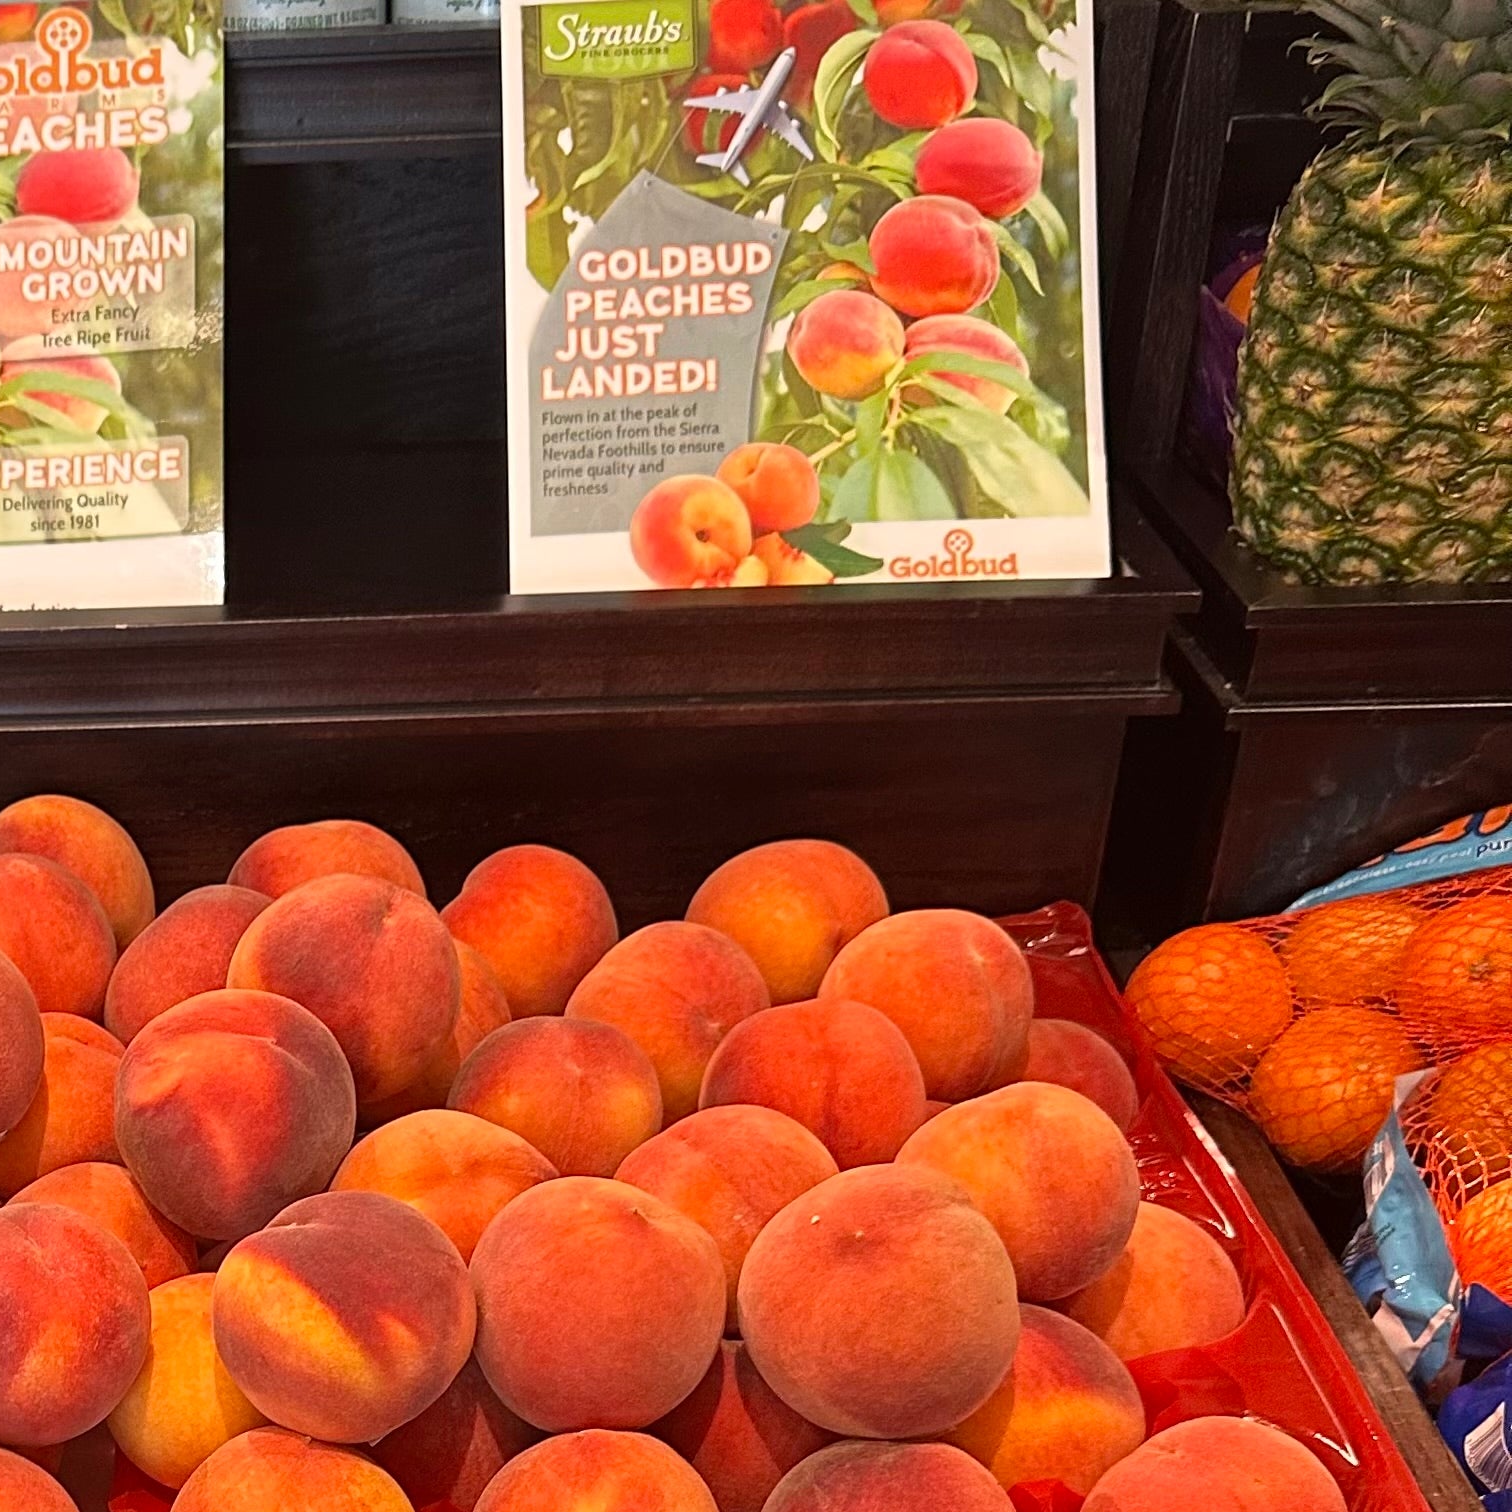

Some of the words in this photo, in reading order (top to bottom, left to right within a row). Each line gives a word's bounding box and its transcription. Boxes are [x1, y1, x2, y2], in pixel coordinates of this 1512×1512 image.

[544, 10, 682, 61] Straub's
[578, 242, 772, 282] GOLDBUD
[22, 262, 164, 302] GROWN
[565, 281, 753, 322] PEACHES
[51, 308, 90, 324] Extra
[95, 305, 140, 326] Fancy
[41, 332, 72, 348] Tree
[77, 330, 111, 350] Ripe
[116, 326, 150, 343] Fruit
[555, 323, 664, 362] JUST
[542, 358, 717, 401] LANDED!
[542, 411, 583, 425] Flown
[587, 410, 600, 423] in
[603, 410, 616, 422] at
[621, 407, 643, 421] the
[646, 405, 679, 422] peak
[683, 402, 698, 417] of
[542, 426, 612, 446] perfection
[616, 425, 650, 440] from
[654, 423, 676, 437] the
[679, 422, 720, 436] Sierra
[543, 446, 594, 461] Nevada
[598, 442, 657, 458] Foothills
[661, 442, 675, 455] to
[678, 441, 725, 454] ensure
[543, 465, 583, 482] prime
[587, 461, 635, 479] quality
[638, 459, 665, 473] and
[543, 482, 609, 497] freshness
[2, 496, 73, 513] Delivering
[77, 492, 129, 509] Quality
[31, 517, 66, 532] since
[70, 514, 100, 530] 1981
[889, 547, 1019, 578] Goldbud
